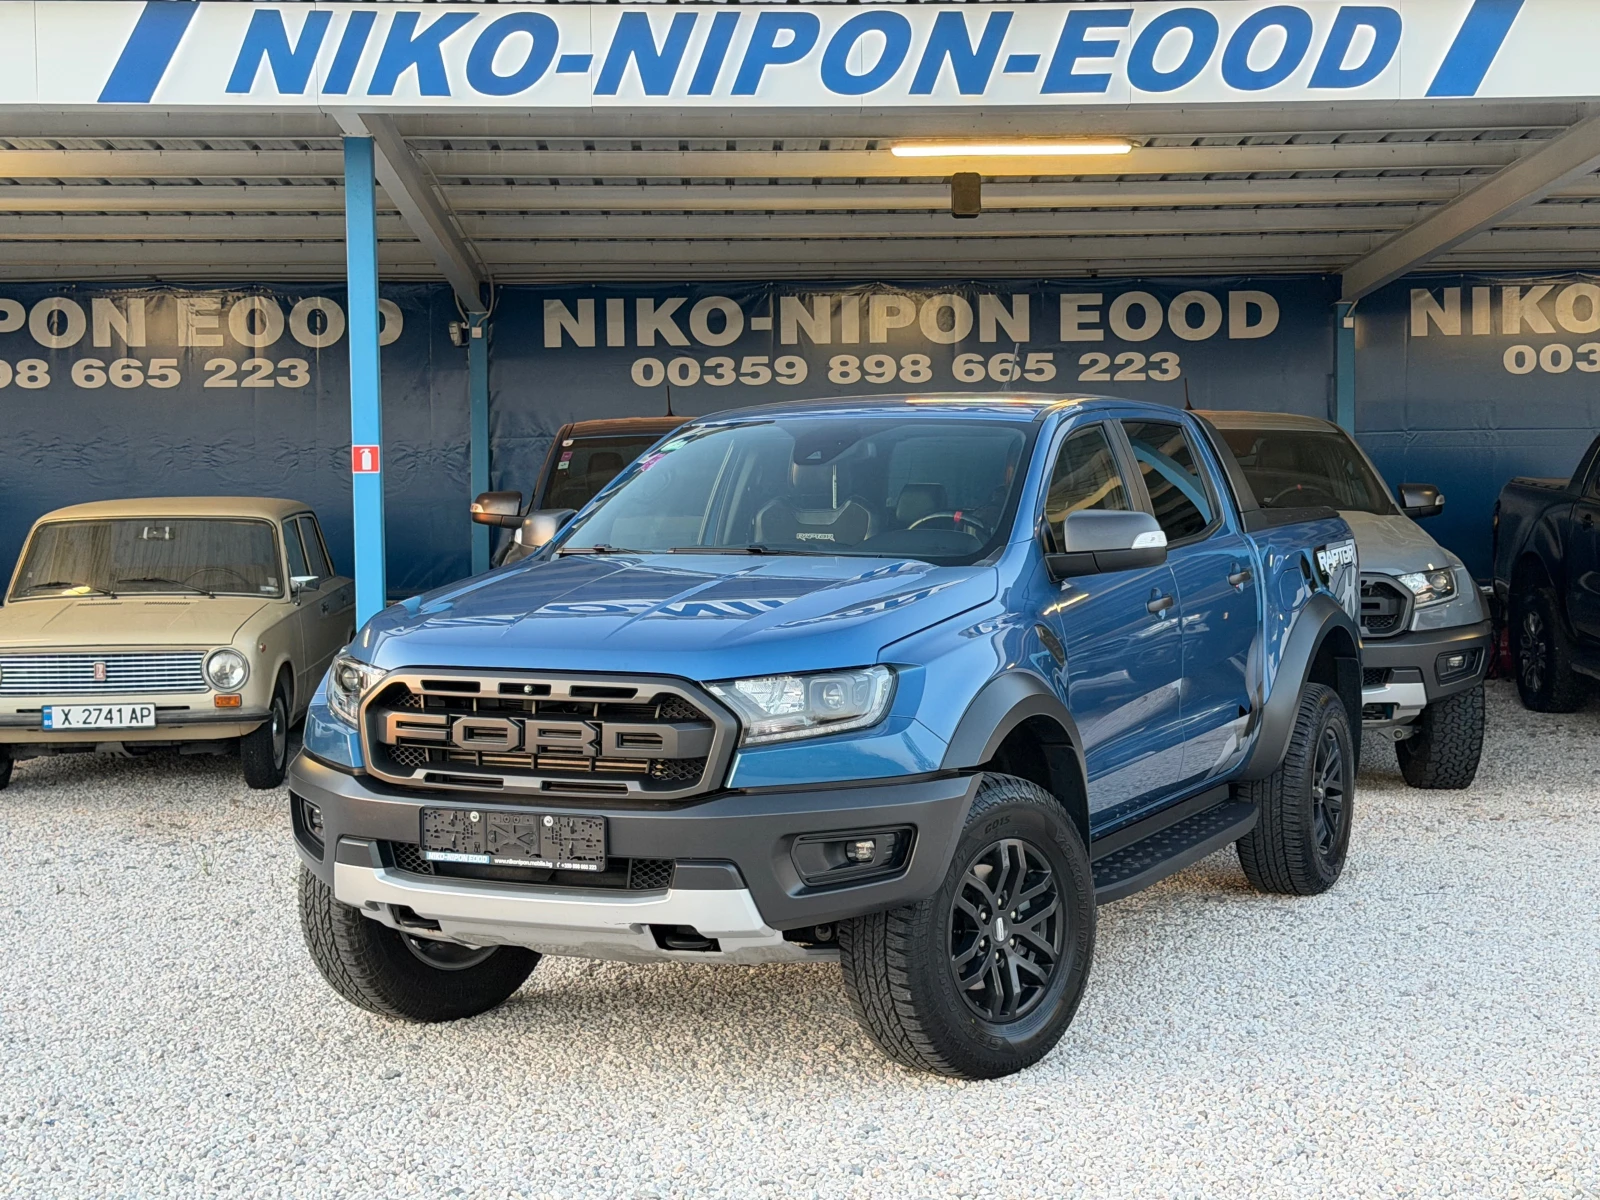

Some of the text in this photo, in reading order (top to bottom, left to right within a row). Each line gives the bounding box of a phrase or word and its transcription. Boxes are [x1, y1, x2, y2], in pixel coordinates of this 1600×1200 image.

[225, 6, 1402, 97] NIKO-NIPON-EOOD
[543, 290, 1280, 348] NIKO-NIPON EOOD
[71, 357, 181, 389] 665
[203, 357, 311, 388] 223
[630, 351, 1181, 388] 00359 898 665 223
[1316, 544, 1357, 576] RAPTOR
[60, 706, 151, 726] X 2741 AP
[378, 711, 690, 759] FORD
